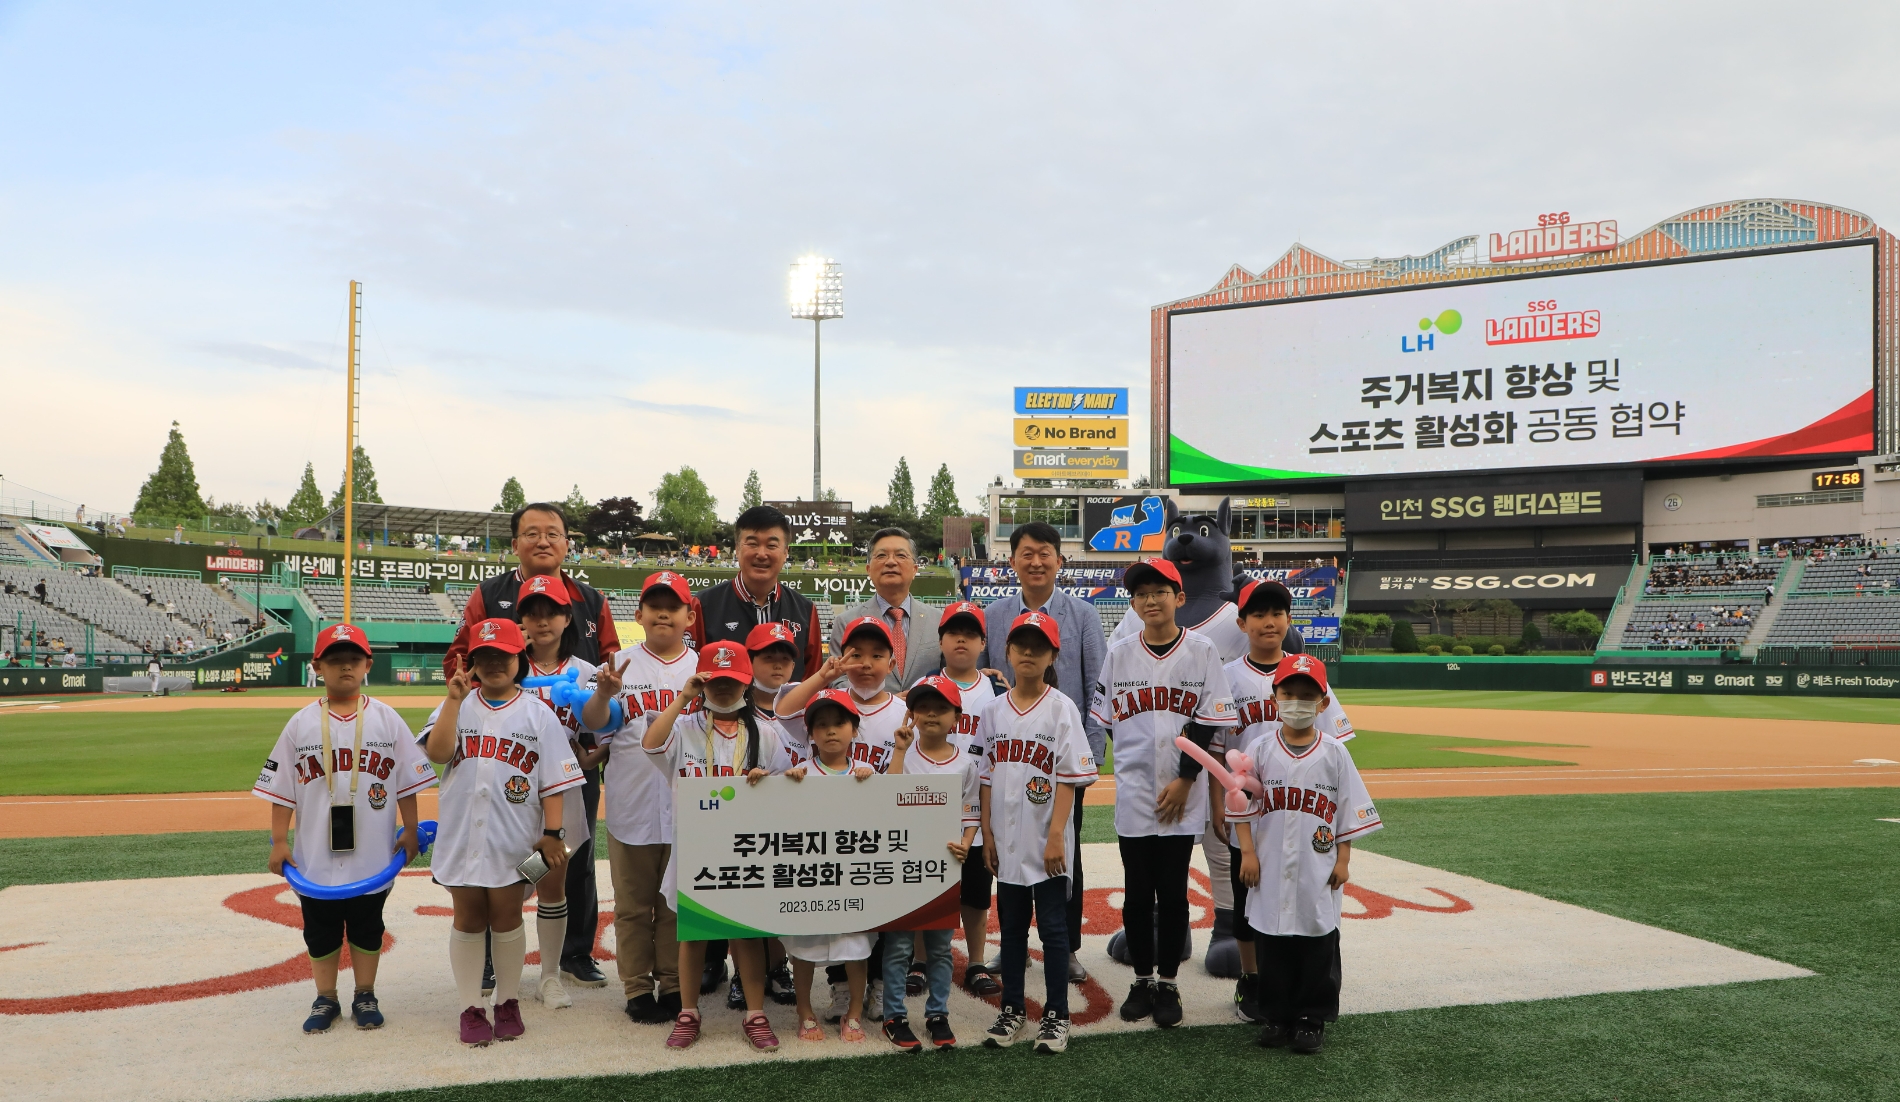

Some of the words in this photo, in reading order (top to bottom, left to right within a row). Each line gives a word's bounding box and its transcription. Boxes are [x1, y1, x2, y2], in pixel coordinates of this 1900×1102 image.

[1538, 212, 1570, 226] SSG
[1489, 220, 1618, 262] LANDERS
[1528, 300, 1557, 312] SSG
[1486, 310, 1600, 346] LANDERS
[1402, 334, 1434, 353] LH
[1360, 368, 1494, 408] 주거복지
[1505, 361, 1577, 398] 향상
[1587, 358, 1620, 393] 및
[1044, 427, 1066, 438] No
[1070, 427, 1116, 438] Brand
[1308, 417, 1404, 454] 스포츠
[1414, 411, 1518, 449] 활성화
[1526, 405, 1597, 442] 공동
[1610, 400, 1686, 438] 협약
[1023, 452, 1066, 466] emart
[1068, 455, 1120, 468] everyday
[1815, 472, 1860, 487] 17:58
[1086, 496, 1116, 504] ROCKET
[1380, 498, 1422, 520] 인천
[1430, 496, 1486, 518] SSG
[1494, 492, 1602, 517] 랜더스필드
[1667, 498, 1678, 508] 26
[1114, 530, 1131, 549] R
[206, 555, 264, 572] LANDERS
[284, 554, 336, 576] 세상에
[380, 560, 463, 580] 프로야구의
[1430, 573, 1596, 590] SSG.COM
[243, 662, 272, 680] 인천탁주
[1611, 671, 1673, 687] 반도건설
[62, 674, 86, 687] emart
[1714, 674, 1755, 686] emart
[1813, 676, 1833, 686] 레츠
[1835, 676, 1862, 686] Fresh
[1112, 686, 1198, 722] LANDER
[512, 732, 538, 742] SSG.COM
[1315, 784, 1338, 792] SSG.COM
[700, 800, 719, 810] LH
[896, 792, 948, 806] LANDERS
[1260, 786, 1337, 825] ANDERS
[734, 832, 828, 858] 주거복지
[834, 830, 881, 855] 향상
[888, 830, 908, 853] 및
[694, 864, 765, 891] 스포츠
[772, 862, 843, 889] 활성화
[849, 861, 894, 886] 공동
[901, 859, 948, 884] 협약
[780, 900, 841, 914] 2023.05.25
